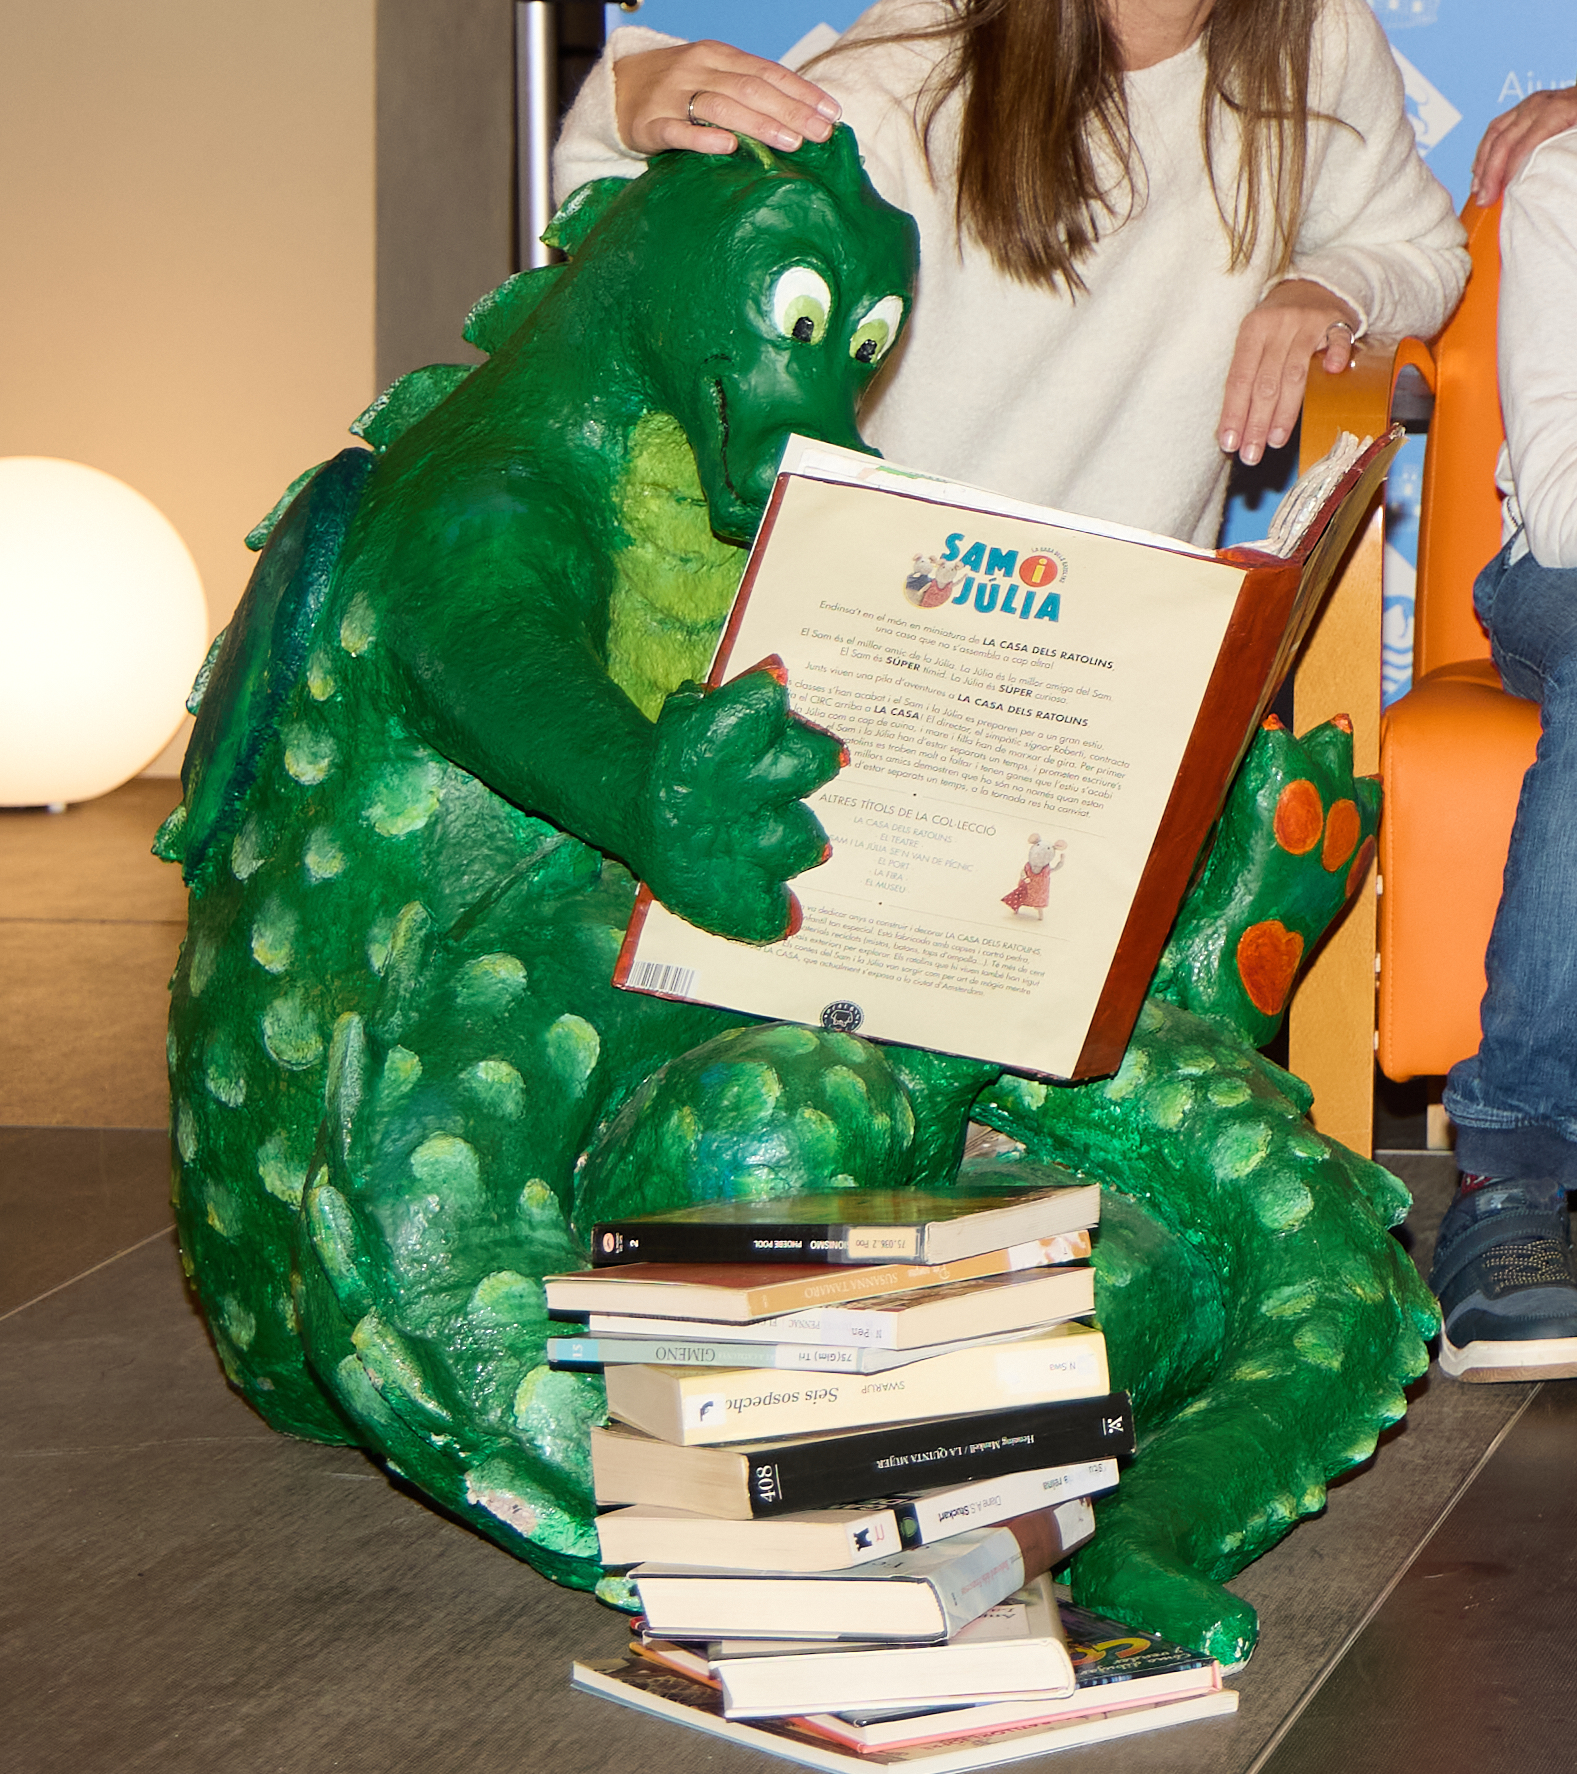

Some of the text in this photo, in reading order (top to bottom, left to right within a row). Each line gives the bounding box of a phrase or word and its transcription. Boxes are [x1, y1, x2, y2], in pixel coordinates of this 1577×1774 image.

[940, 532, 1019, 578] SAM
[951, 575, 1061, 623] JÚLIA
[982, 637, 996, 649] LA
[999, 641, 1030, 654] CASA
[1032, 645, 1057, 658] DELS
[957, 693, 971, 704] LA
[974, 697, 1005, 710] CASA
[1007, 703, 1032, 717] DELS
[819, 792, 858, 809] ALTRES
[860, 797, 895, 817] TÍTOLS
[898, 807, 913, 820] DE
[916, 810, 929, 823] LA
[754, 1238, 774, 1249] POOL
[804, 1271, 899, 1299] SUSANNA TAMARO
[655, 1346, 716, 1362] GIMENO
[861, 1380, 906, 1395] SWARUP
[726, 1387, 839, 1413] Seis sospecho
[876, 1454, 910, 1470] MUJER
[910, 1447, 949, 1463] QUINTA
[950, 1446, 963, 1458] LA
[756, 1464, 777, 1503] 408
